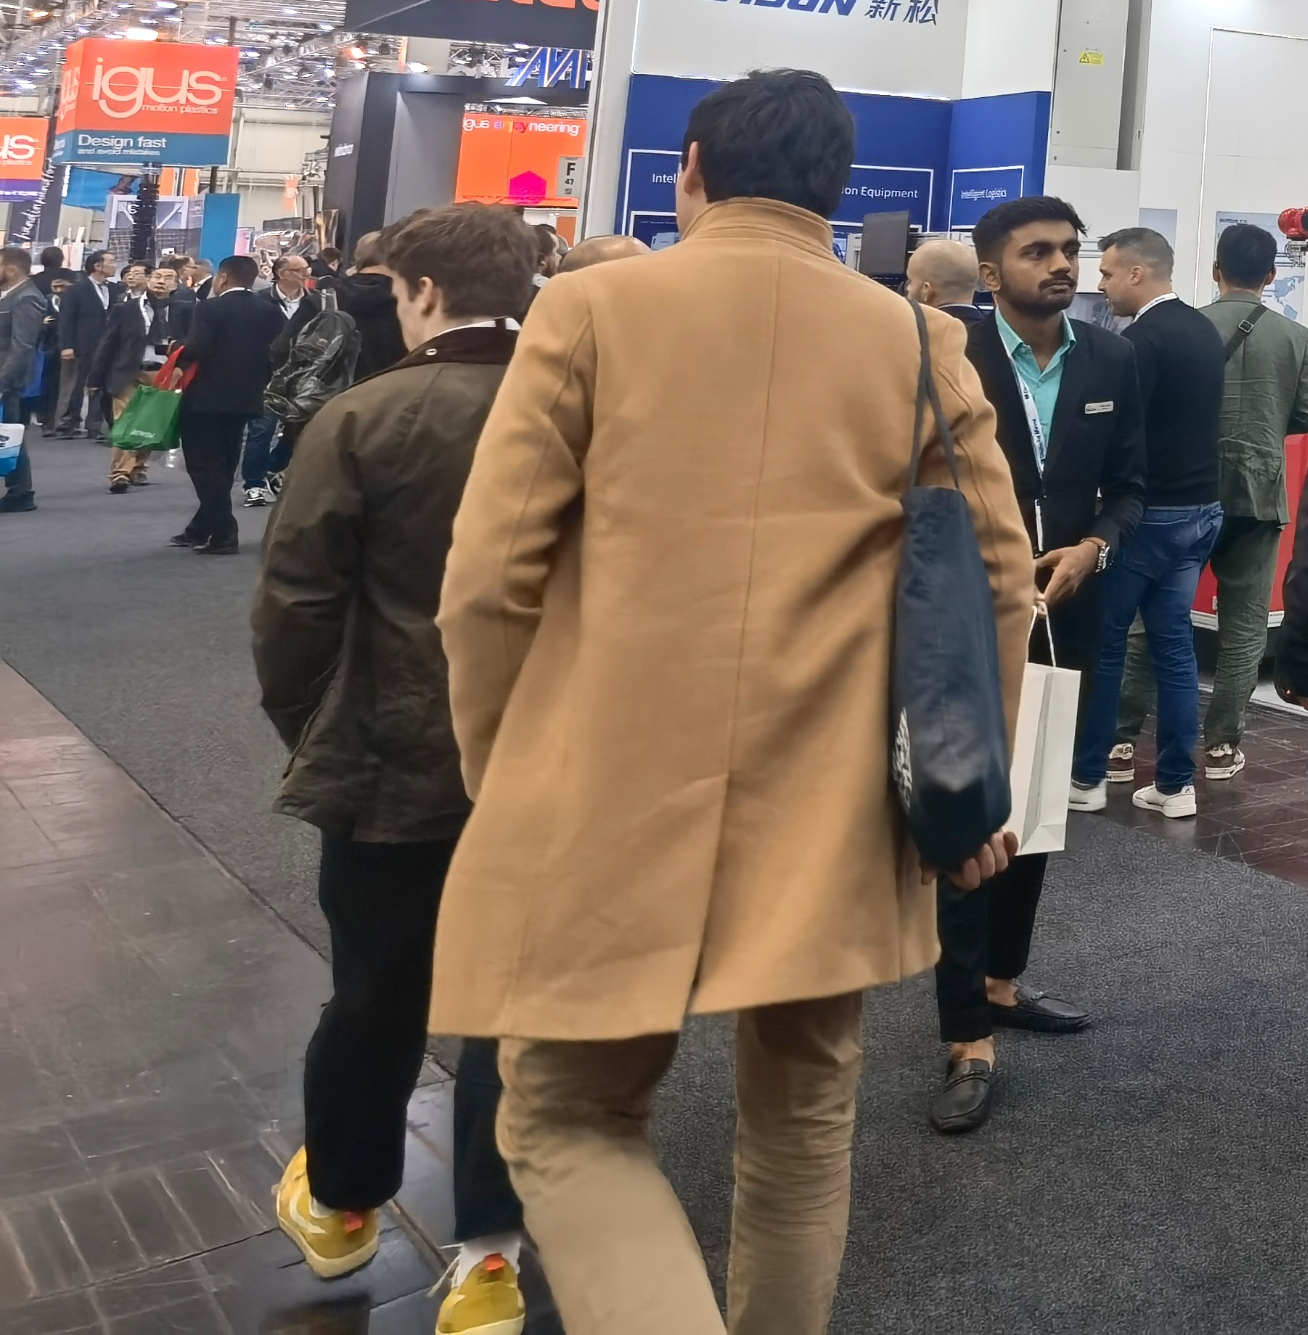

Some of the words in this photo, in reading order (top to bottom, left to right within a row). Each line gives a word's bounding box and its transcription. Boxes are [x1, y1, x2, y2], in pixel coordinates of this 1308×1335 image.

[92, 57, 223, 119] igus
[78, 134, 134, 150] Design
[137, 136, 168, 148] fast
[566, 162, 576, 176] F
[564, 178, 575, 186] 47
[861, 186, 919, 200] Equipment
